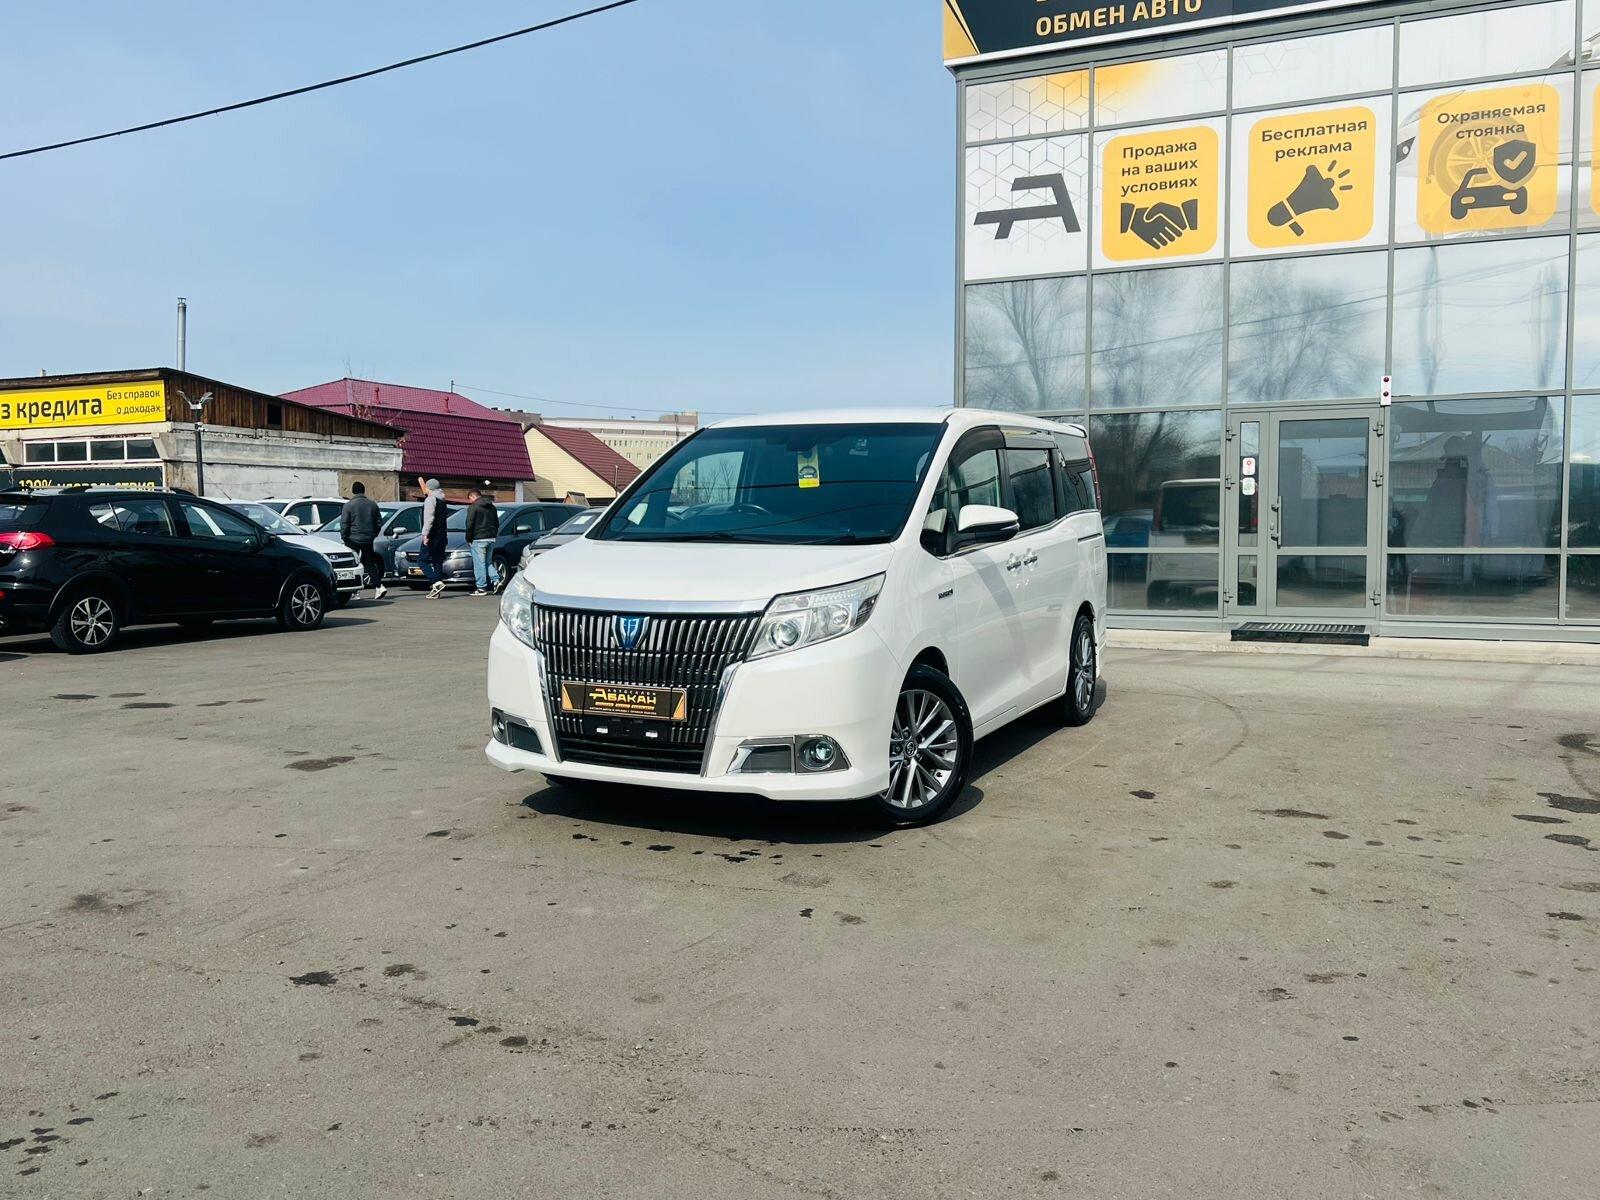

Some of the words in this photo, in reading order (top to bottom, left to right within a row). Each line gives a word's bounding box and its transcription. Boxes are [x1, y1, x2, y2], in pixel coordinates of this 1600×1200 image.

[1036, 4, 1125, 36] ОБМЕН
[1437, 103, 1546, 124] Охраняемая
[1262, 120, 1368, 142] Бесплатная
[1456, 123, 1525, 139] стоянка
[1123, 141, 1197, 159] Продажа
[1275, 141, 1352, 162] реклама
[1121, 166, 1140, 176] на
[1145, 159, 1198, 174] ваших
[1120, 178, 1198, 198] условиях
[106, 390, 122, 400] Без
[123, 389, 161, 401] справок
[17, 398, 102, 423] кредита
[116, 405, 122, 414] о
[123, 403, 161, 414] доходах
[589, 688, 656, 704] АБАКАН
